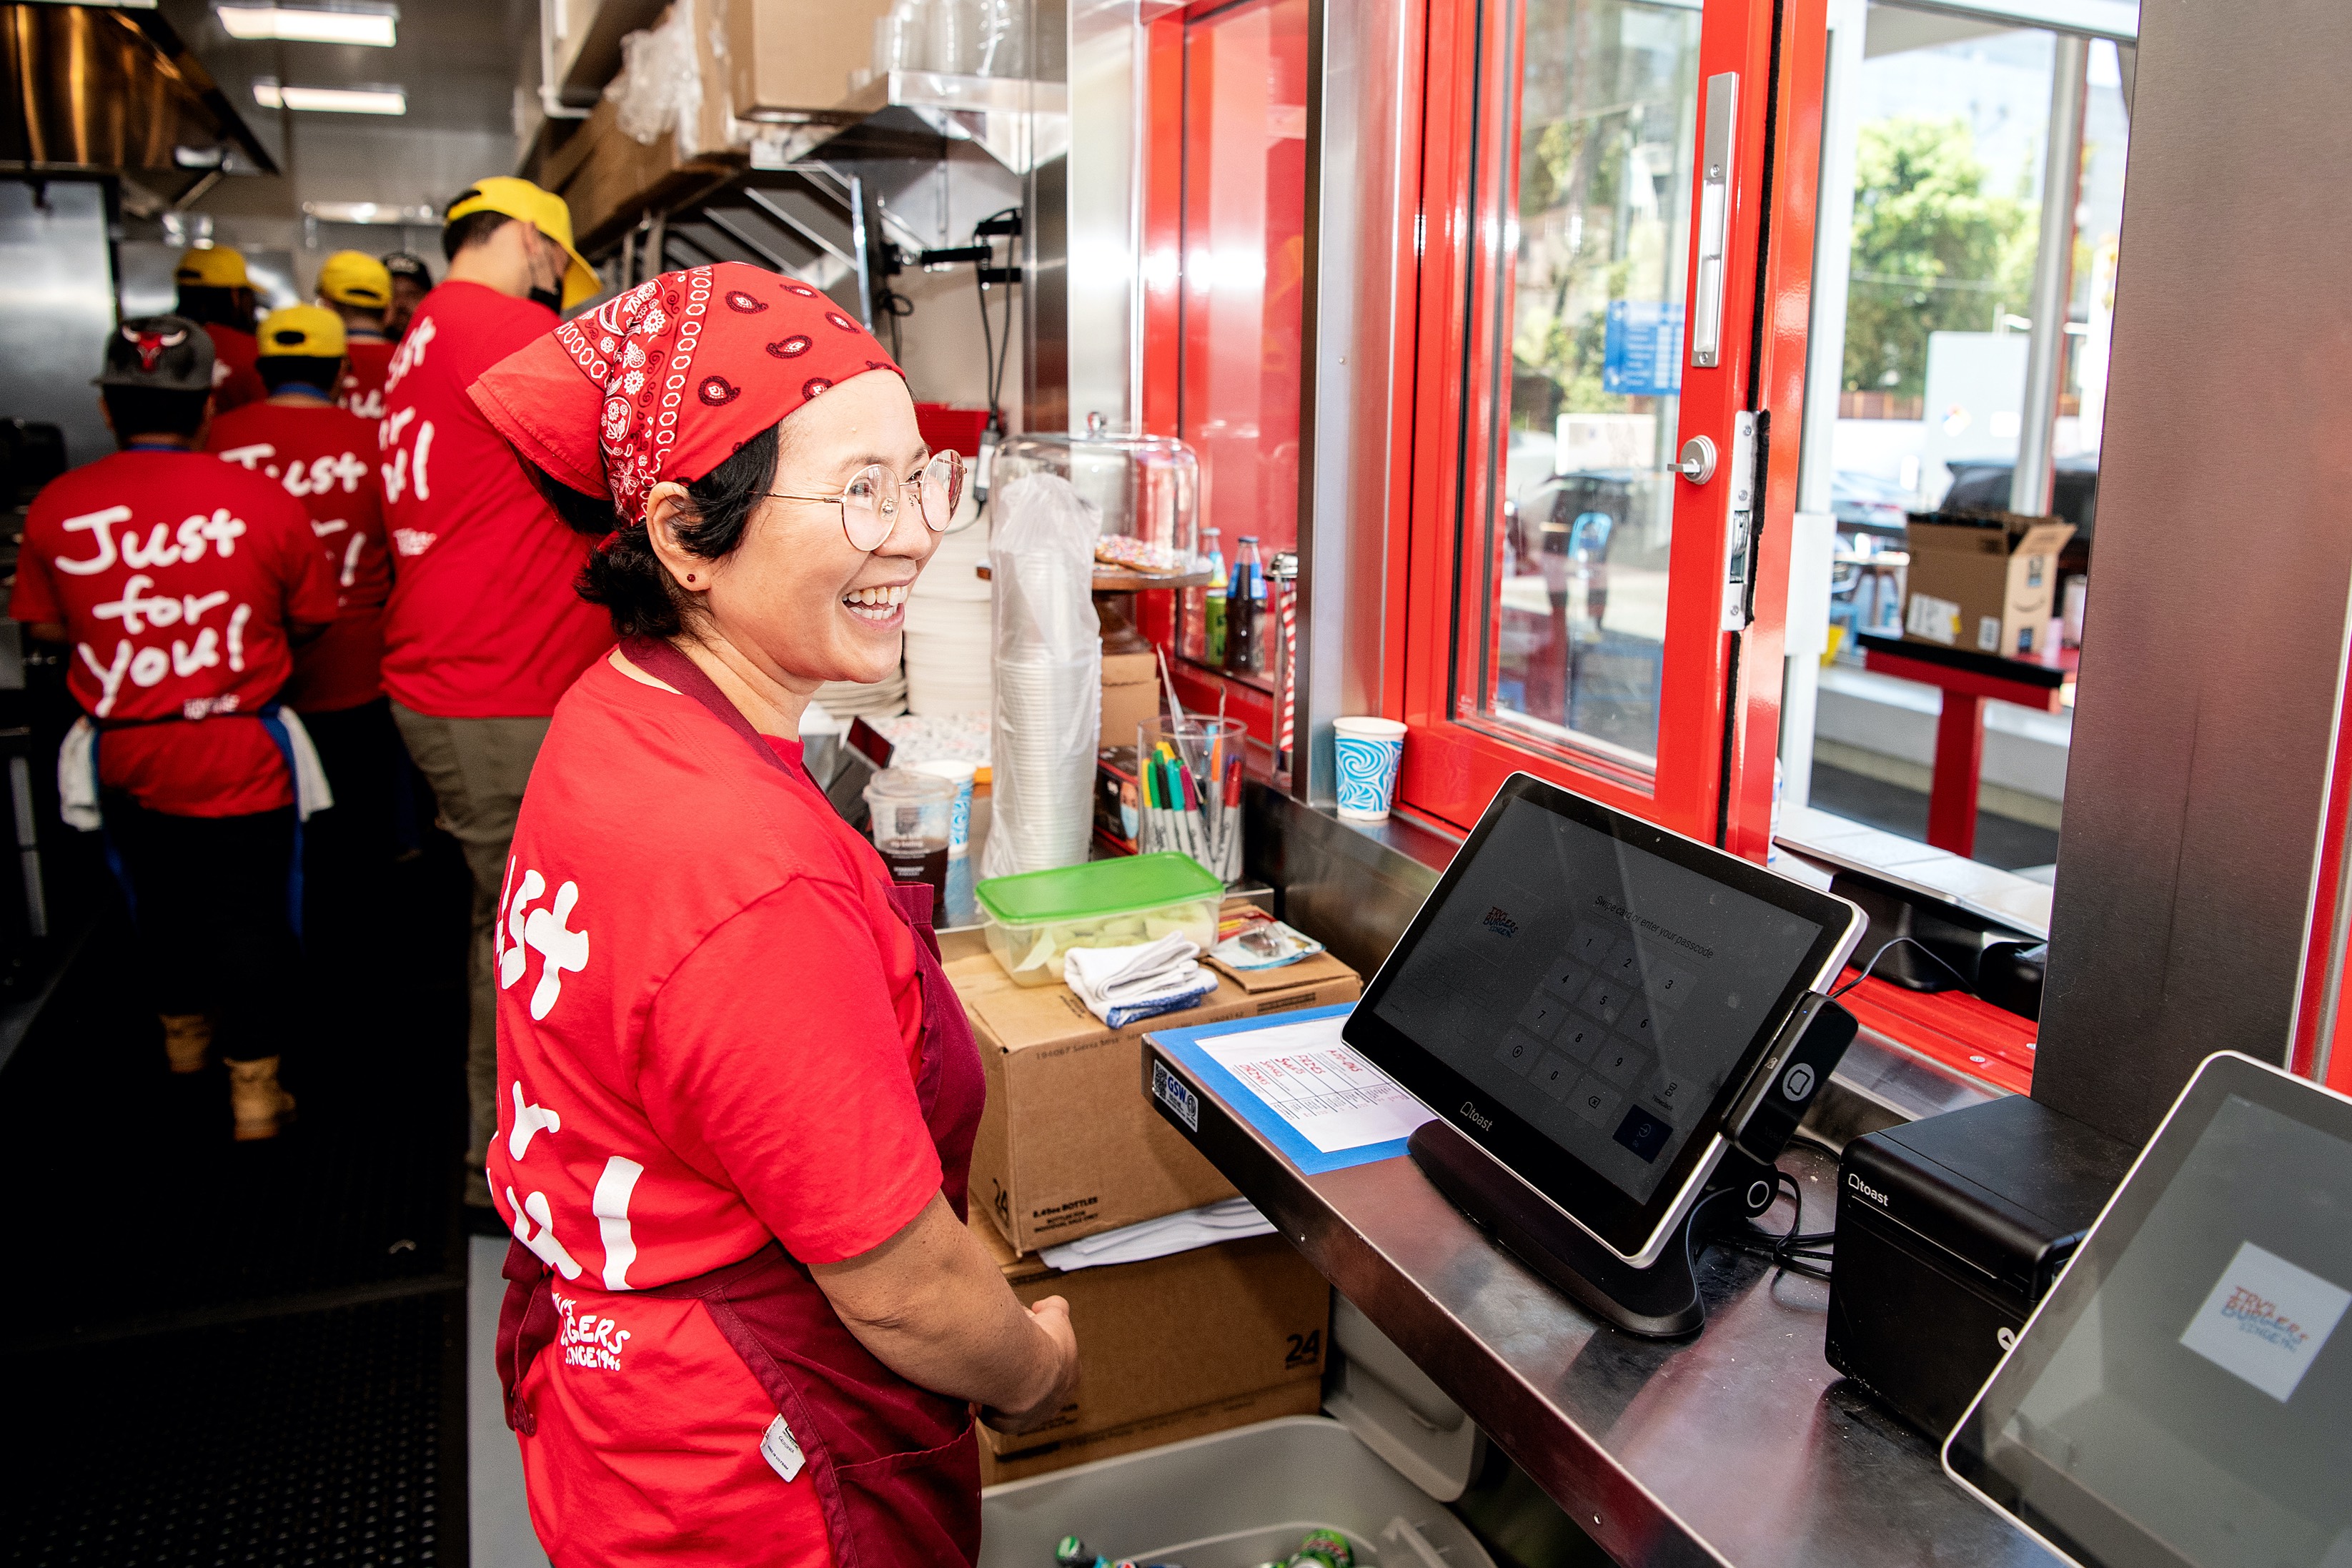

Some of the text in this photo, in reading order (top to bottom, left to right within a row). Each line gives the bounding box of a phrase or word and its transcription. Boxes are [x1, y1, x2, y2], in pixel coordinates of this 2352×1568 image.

[54, 505, 247, 576] Just
[91, 574, 231, 635] for
[77, 602, 252, 719] you!
[1483, 915, 1519, 933] BURGERS
[1595, 895, 1714, 959] Swipe card or enter your passcode
[1585, 938, 1593, 948] 1
[1622, 958, 1632, 968] 2
[1562, 974, 1569, 984] 4
[1664, 979, 1674, 990] 3
[1599, 995, 1608, 1006] 5
[1537, 1010, 1547, 1020] 7
[1639, 1018, 1649, 1028] 6
[1574, 1033, 1584, 1043] 8
[1614, 1057, 1624, 1067] 9
[1550, 1071, 1559, 1081] 0
[1167, 1076, 1187, 1104] GSW
[1469, 1108, 1493, 1132] toast
[1860, 1180, 1889, 1207] toast
[1286, 1330, 1321, 1362] 24
